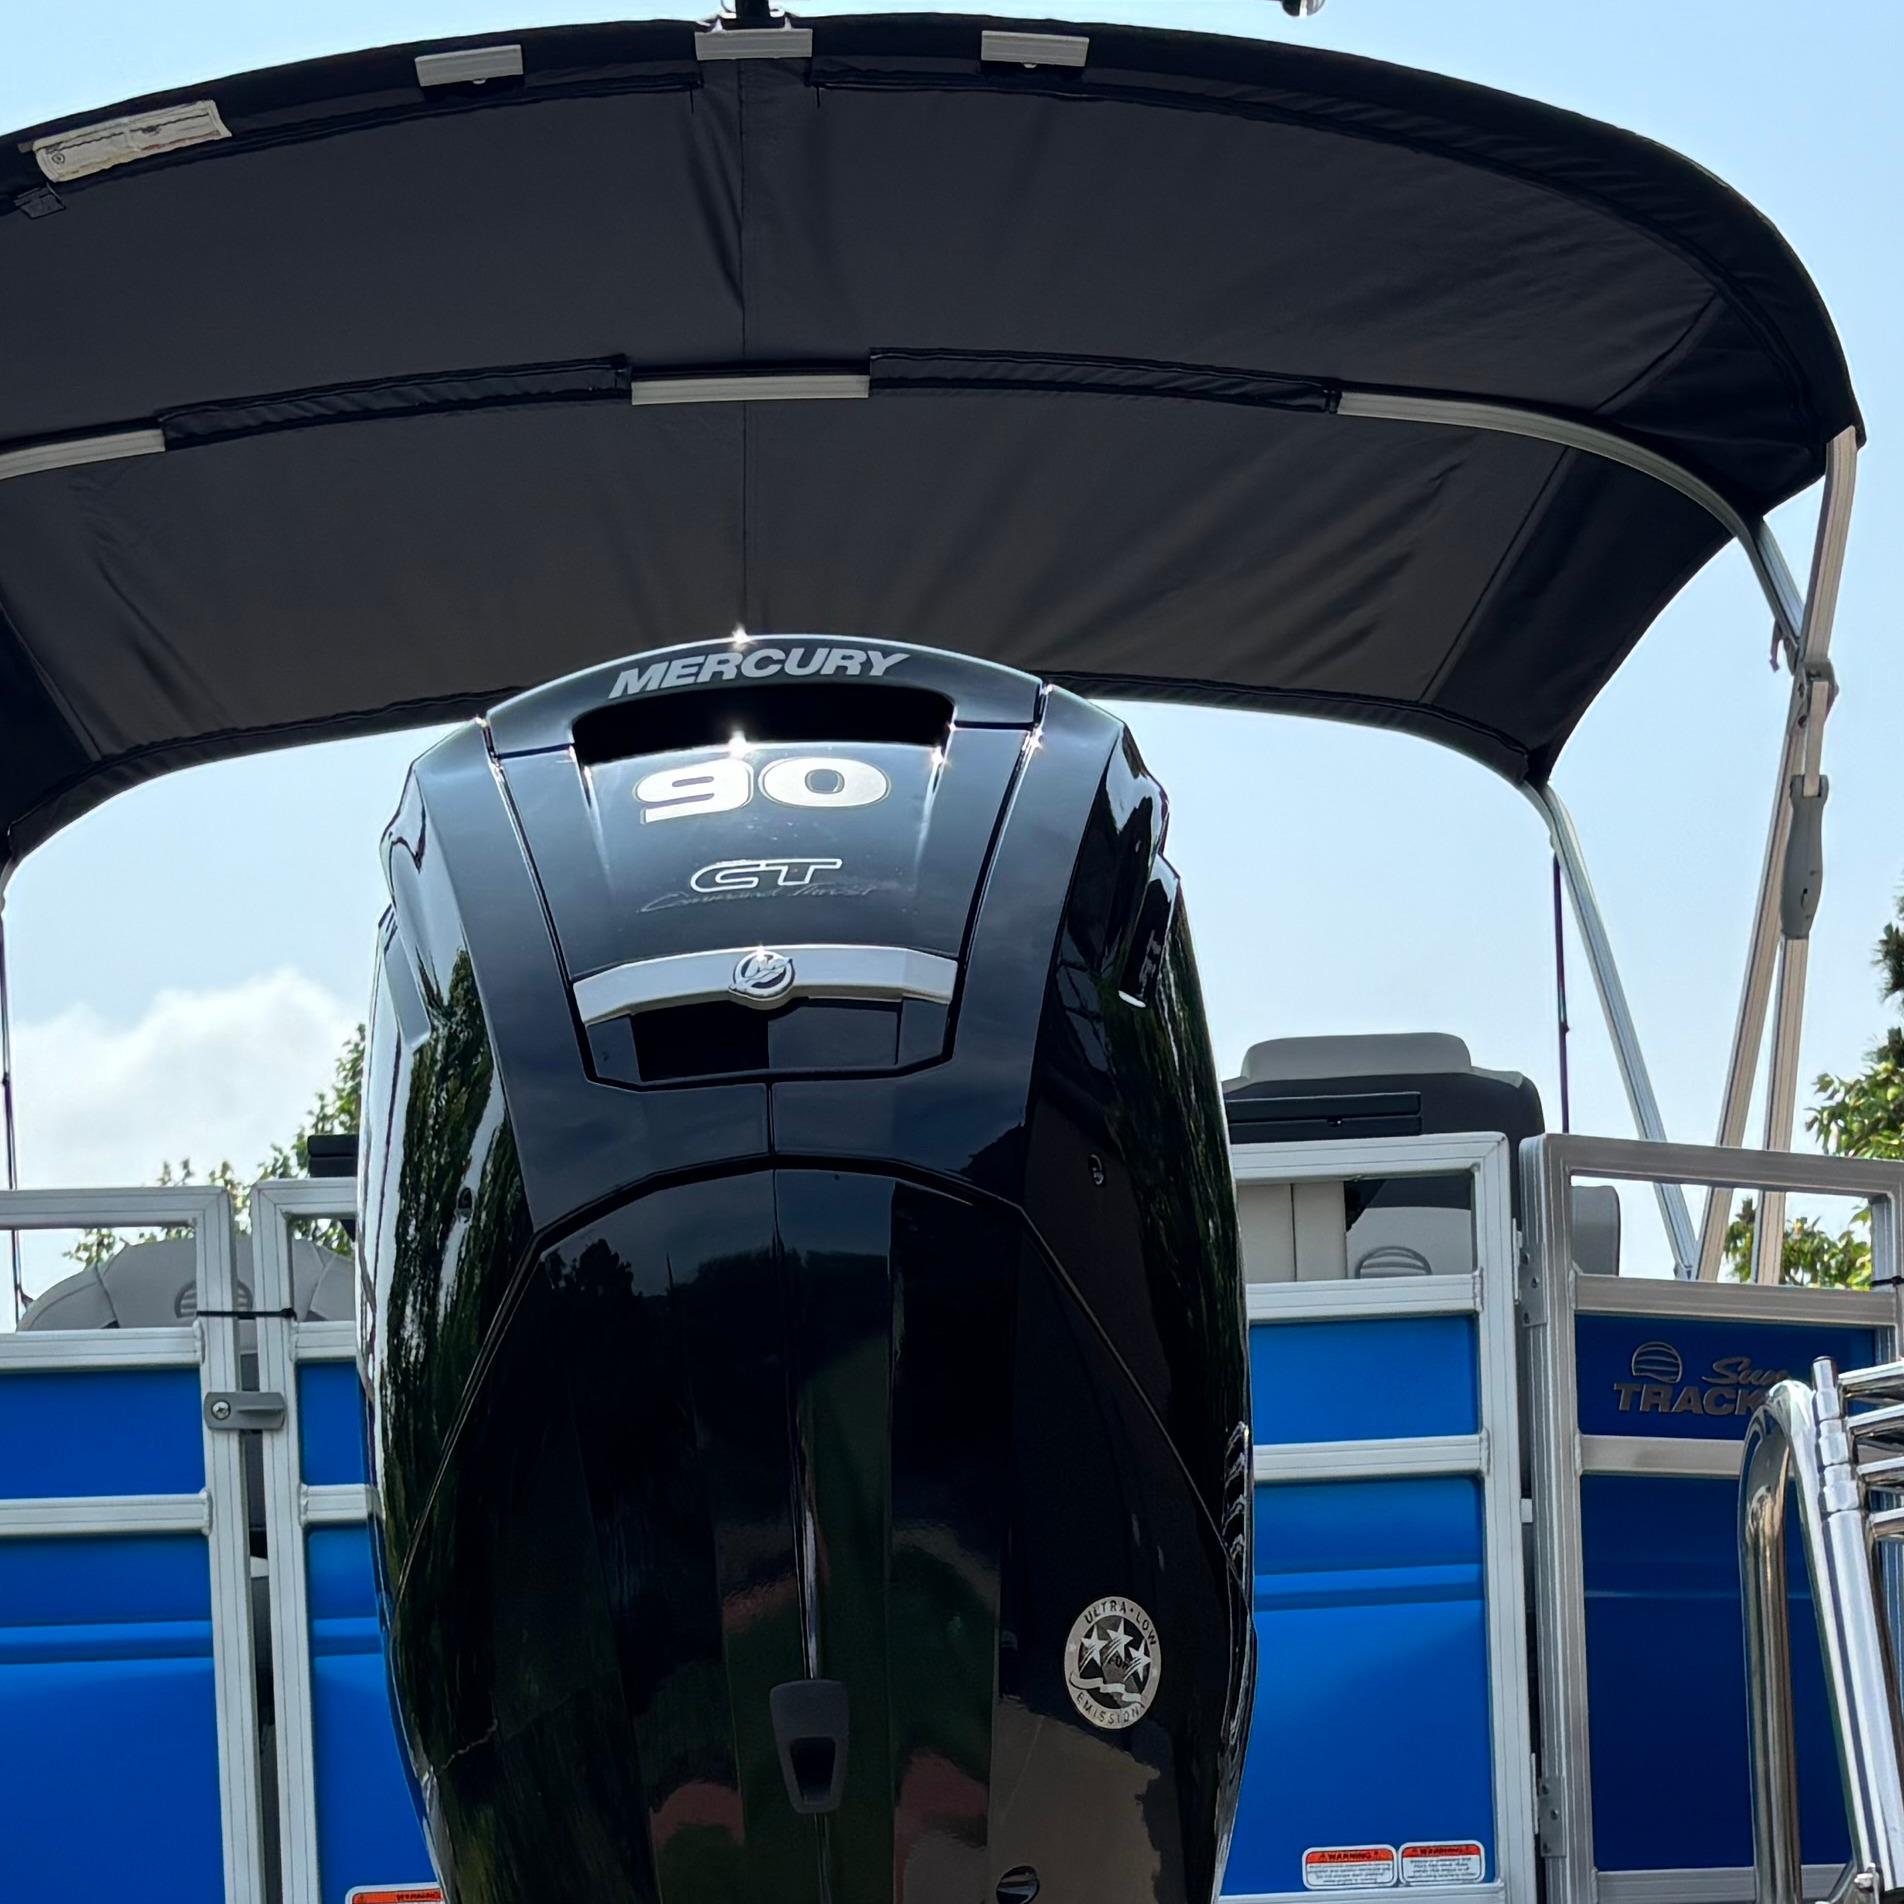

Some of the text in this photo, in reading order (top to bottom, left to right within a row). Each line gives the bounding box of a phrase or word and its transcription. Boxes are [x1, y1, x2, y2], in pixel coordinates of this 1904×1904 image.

[607, 647, 911, 699] MERCURY
[631, 757, 891, 825] 90
[1701, 1356, 1789, 1385] Sun
[1614, 1382, 1769, 1416] TRACK
[1084, 1600, 1157, 1645] ULTRA LOW
[1076, 1691, 1142, 1725] EMISSION
